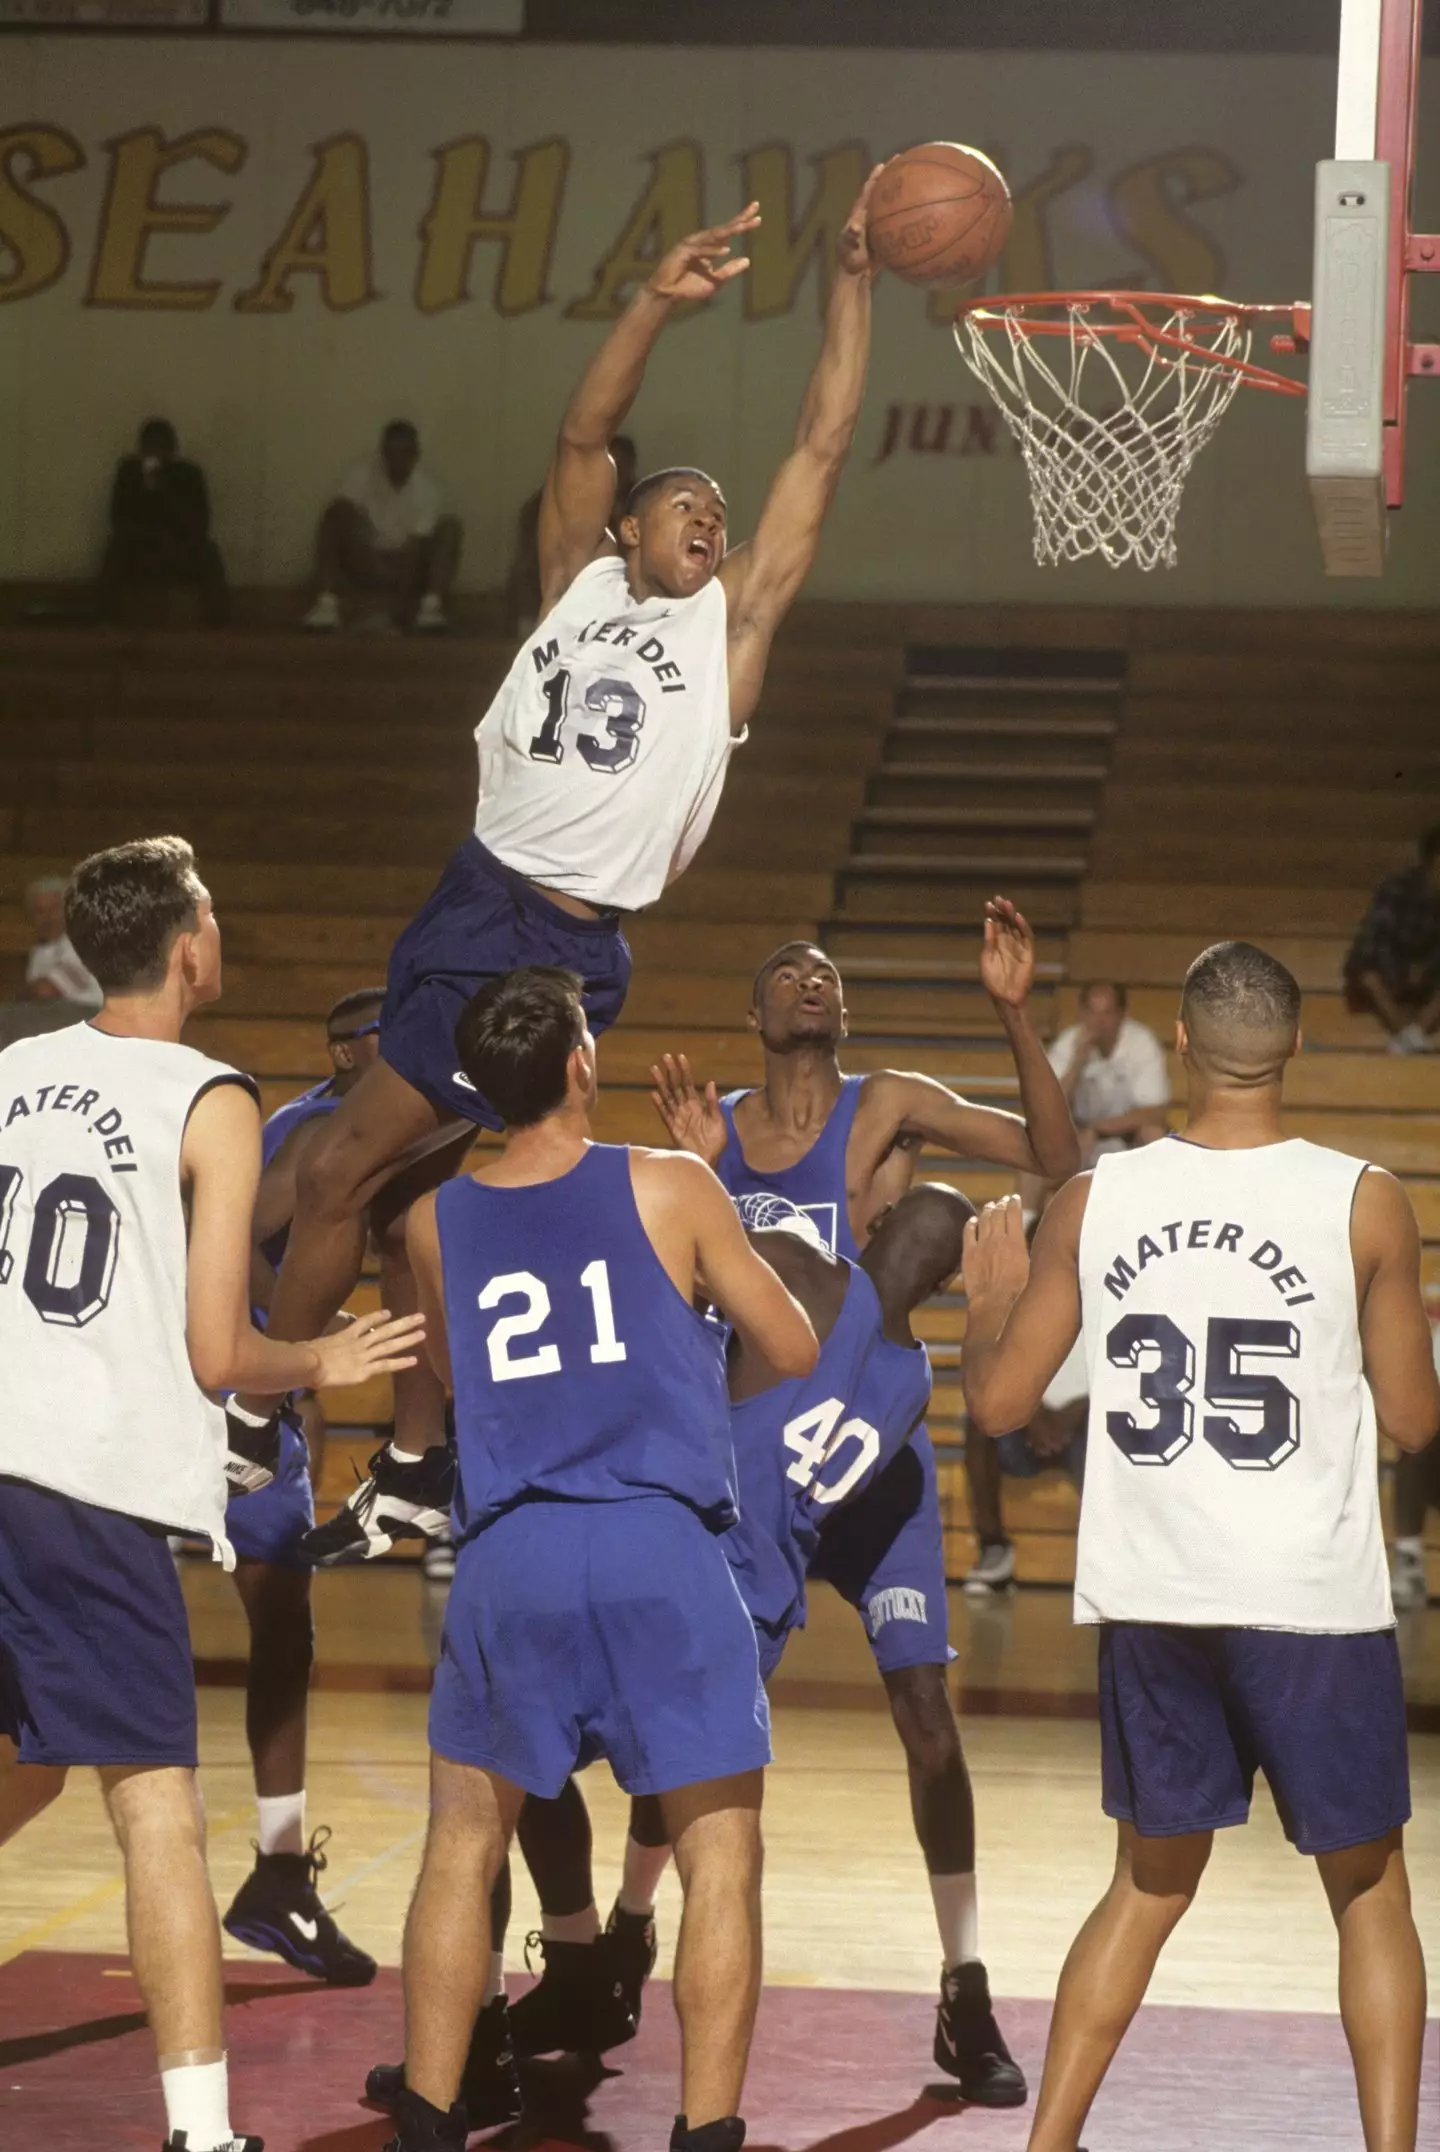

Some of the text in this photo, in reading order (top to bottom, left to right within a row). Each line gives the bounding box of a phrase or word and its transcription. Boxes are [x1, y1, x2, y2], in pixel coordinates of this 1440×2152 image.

[532, 620, 686, 693] MTER DEI
[529, 669, 647, 775] 13
[0, 1084, 138, 1173] ATER DEI
[1103, 1219, 1315, 1307] MATER DEI
[478, 1260, 626, 1382] 21
[1106, 1313, 1300, 1471] 35
[783, 1398, 880, 1504] 40
